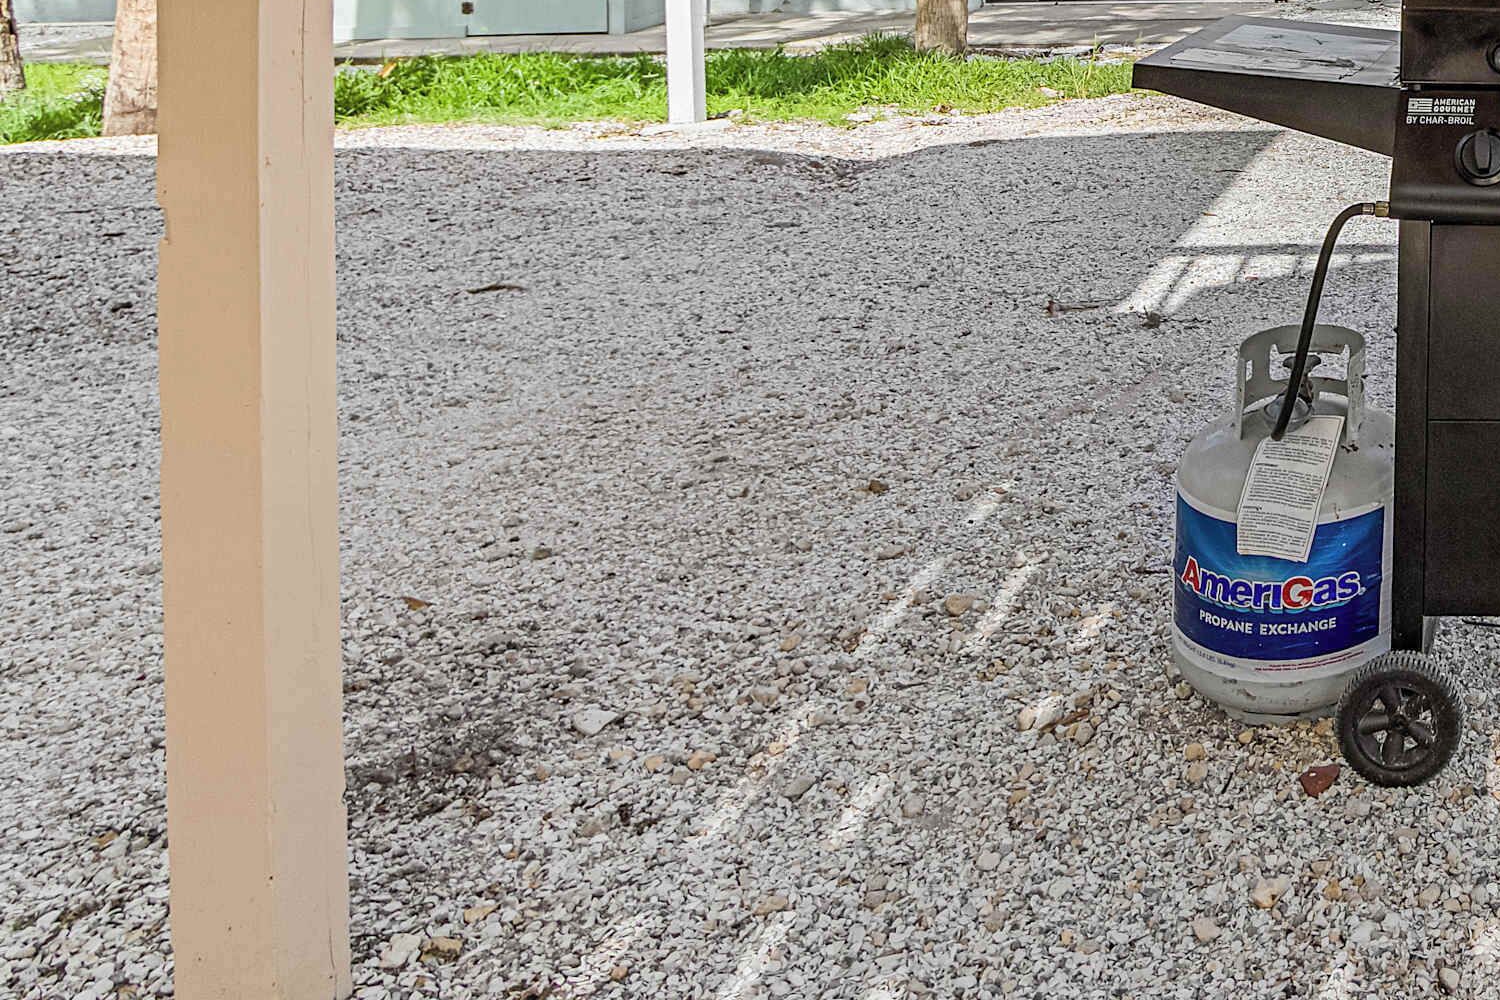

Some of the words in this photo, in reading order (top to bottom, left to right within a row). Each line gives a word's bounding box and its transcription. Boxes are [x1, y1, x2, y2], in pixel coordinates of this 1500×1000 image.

[1434, 98, 1476, 106] AMERICAN
[1406, 115, 1418, 124] BY
[1419, 116, 1475, 125] CHAR-BROIL
[1181, 555, 1362, 609] AmeriGas
[1200, 609, 1253, 635] PROPANE
[1259, 617, 1337, 636] EXCHANGE
